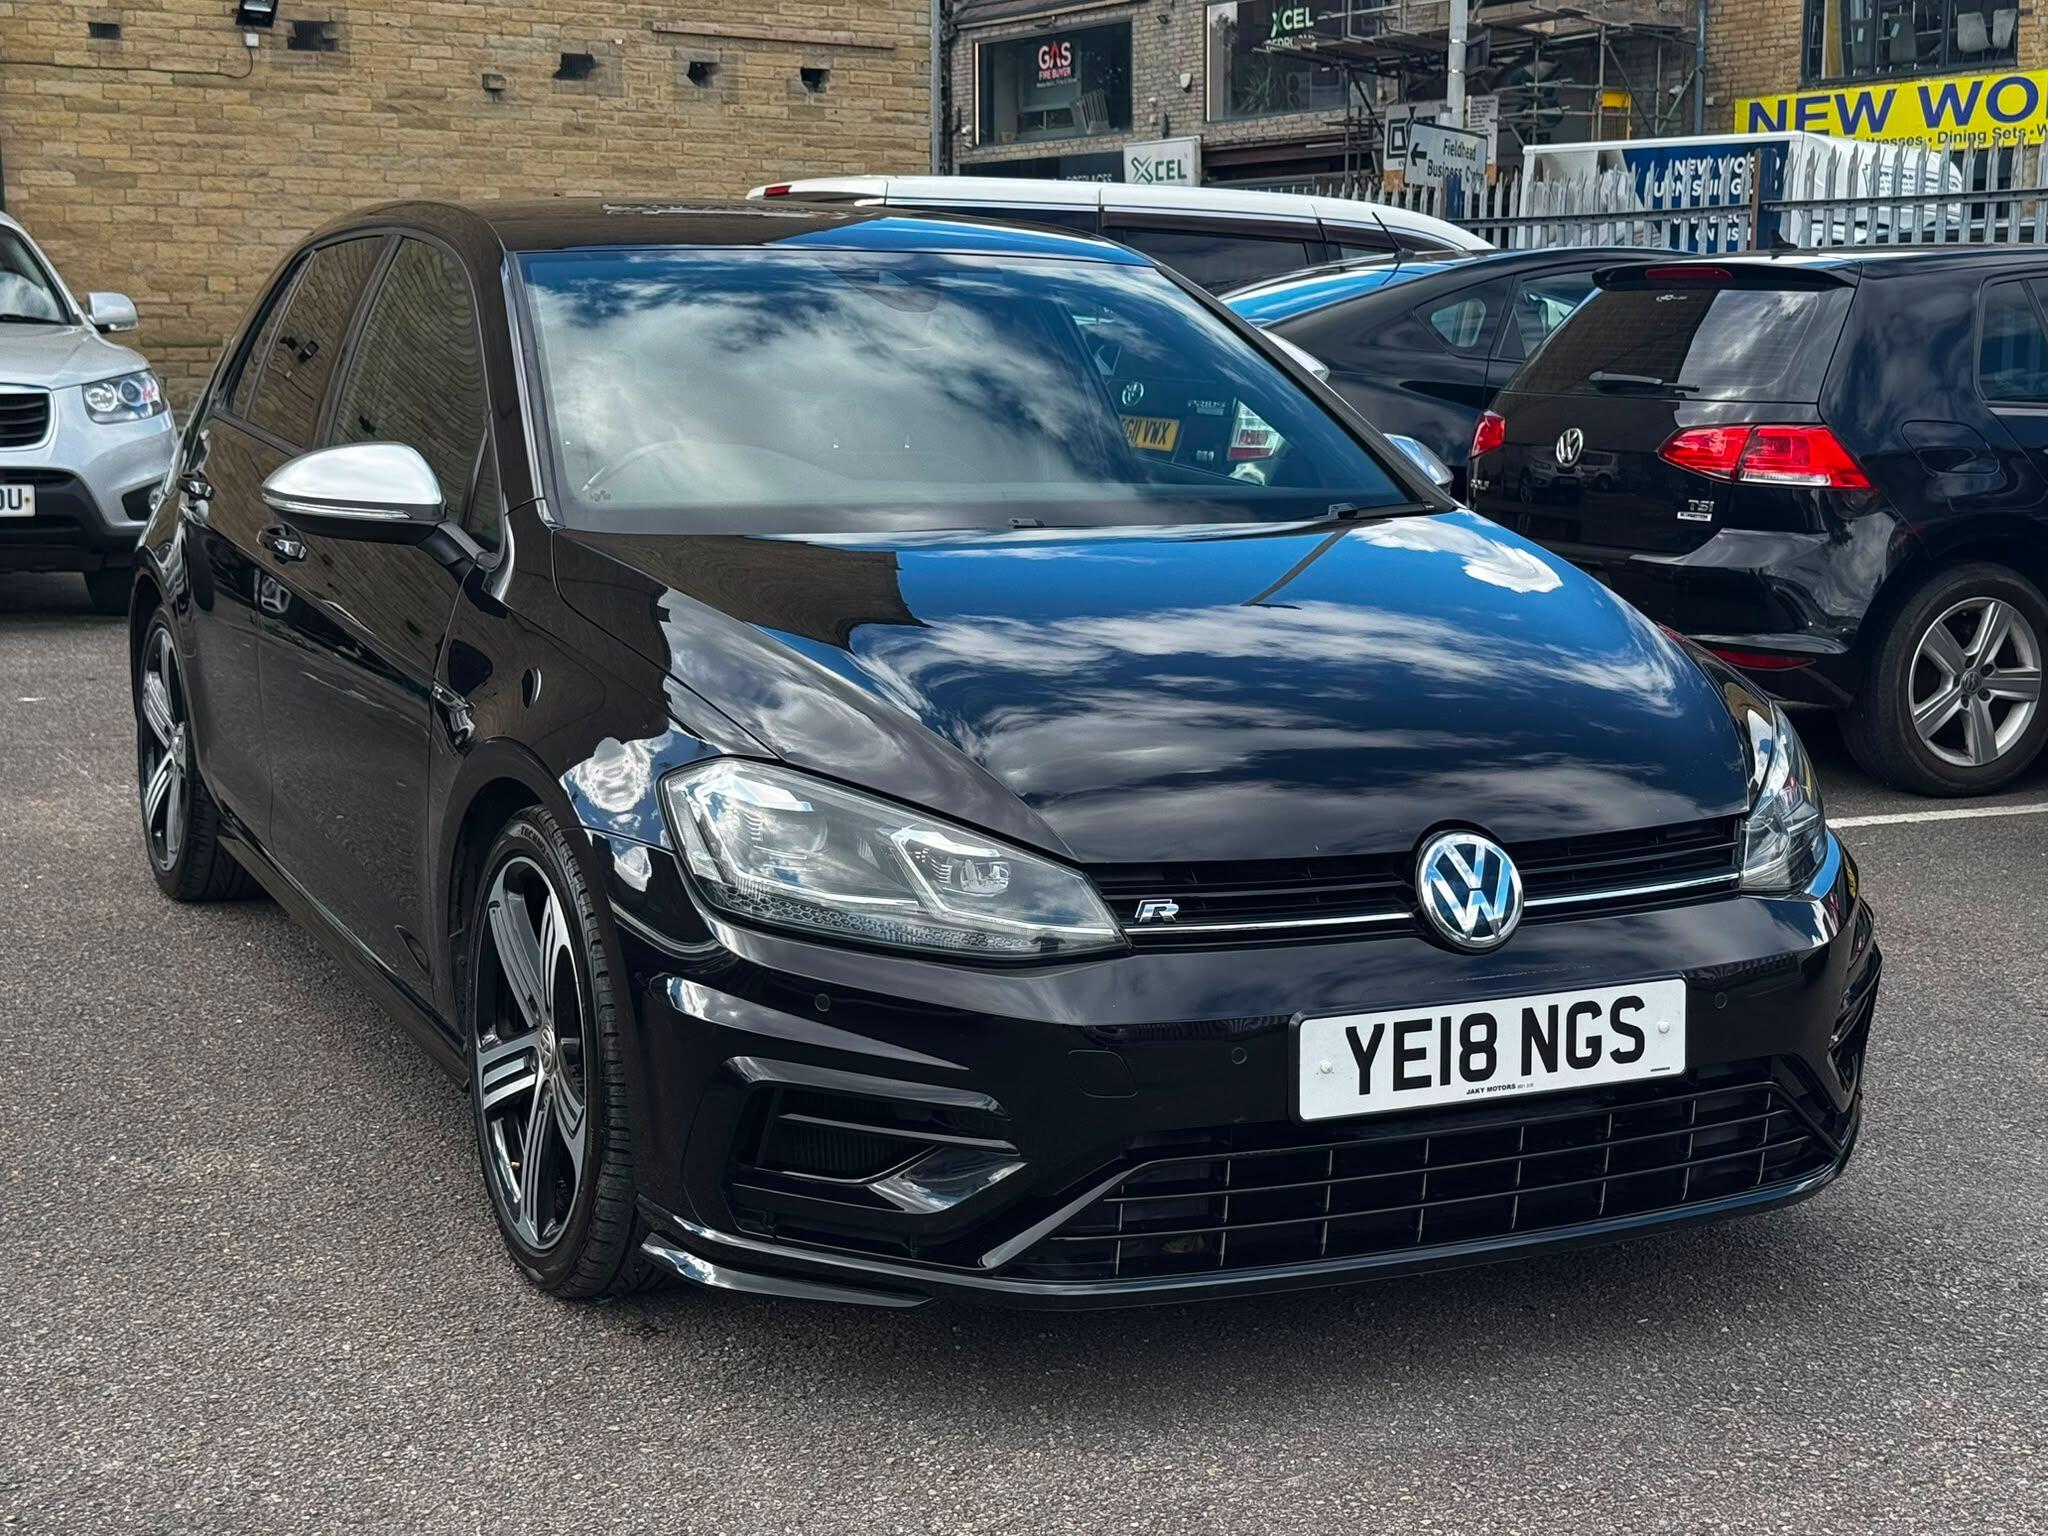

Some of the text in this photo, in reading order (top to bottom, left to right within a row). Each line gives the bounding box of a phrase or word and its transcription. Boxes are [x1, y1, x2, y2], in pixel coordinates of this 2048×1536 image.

[1270, 7, 1315, 38] XCEL
[1038, 41, 1072, 70] GAS
[1750, 76, 2048, 136] NEW WO
[1443, 138, 1477, 161] Fieldhead
[1937, 130, 1986, 147] Dining
[1992, 126, 2026, 142] Sets
[1131, 156, 1187, 184] XCEL
[1344, 994, 1646, 1096] YE18 NGS
[1466, 1087, 1486, 1096] JAKY
[1486, 1083, 1517, 1093] MOTORS
